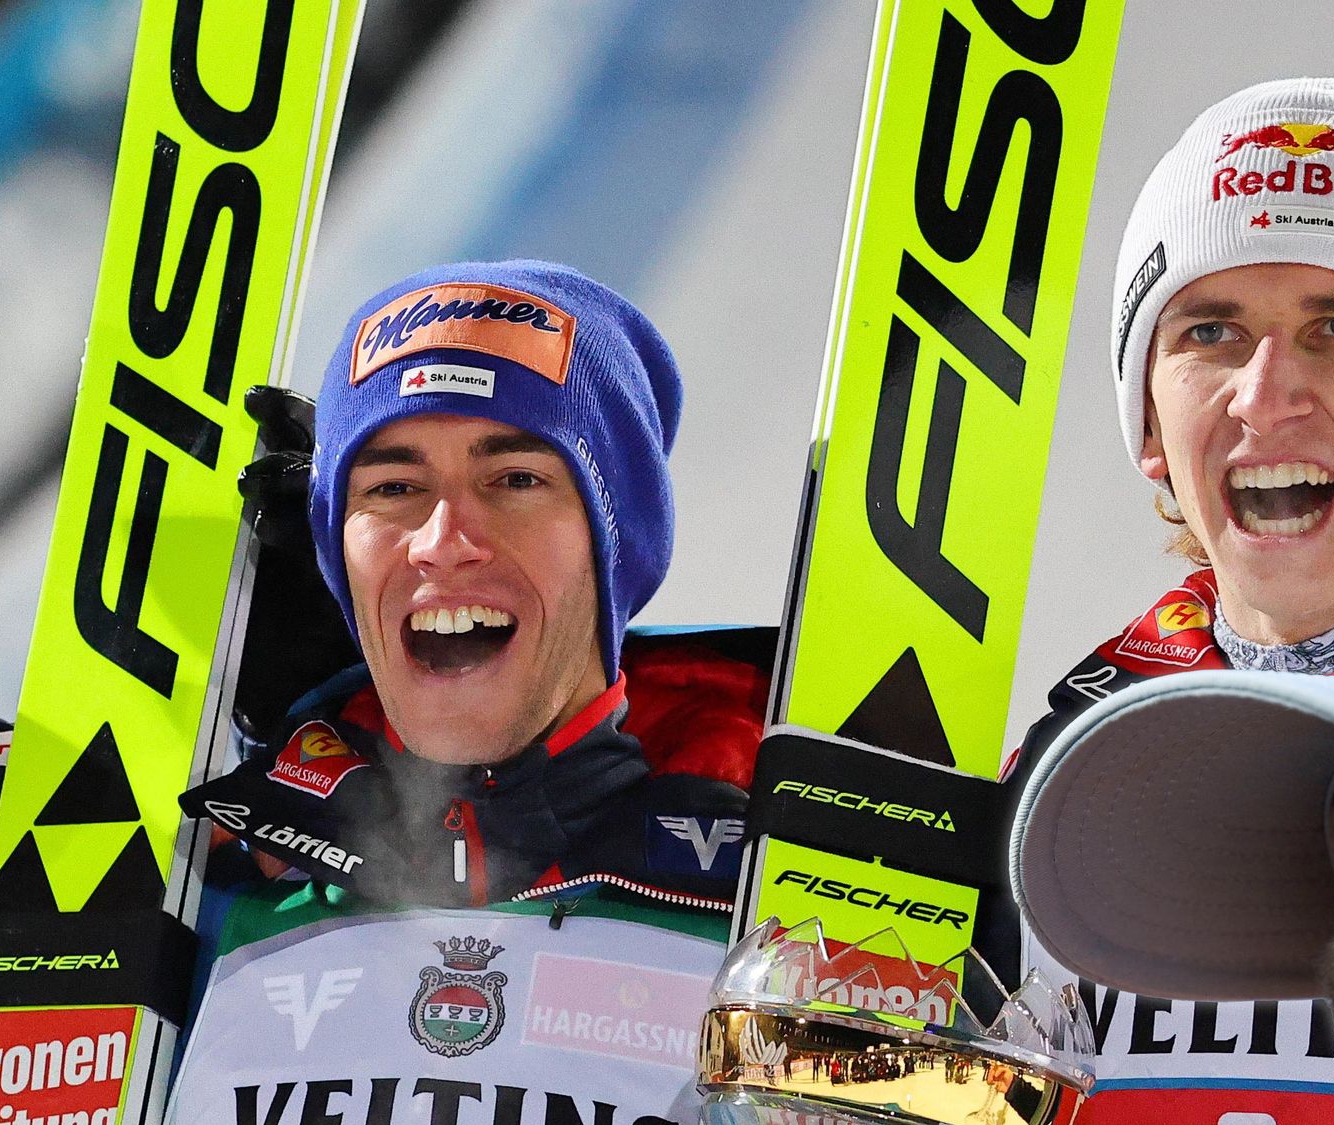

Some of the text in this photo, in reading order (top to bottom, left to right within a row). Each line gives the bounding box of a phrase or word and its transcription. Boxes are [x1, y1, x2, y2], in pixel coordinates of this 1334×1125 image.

[1212, 160, 1295, 201] Red
[1275, 213, 1334, 228] Ski Austria
[363, 293, 561, 364] Manner
[430, 372, 488, 387] Ski Austria
[1126, 638, 1198, 660] HARGASSNER
[772, 781, 936, 829] FISCHER
[773, 869, 969, 930] FISCHER
